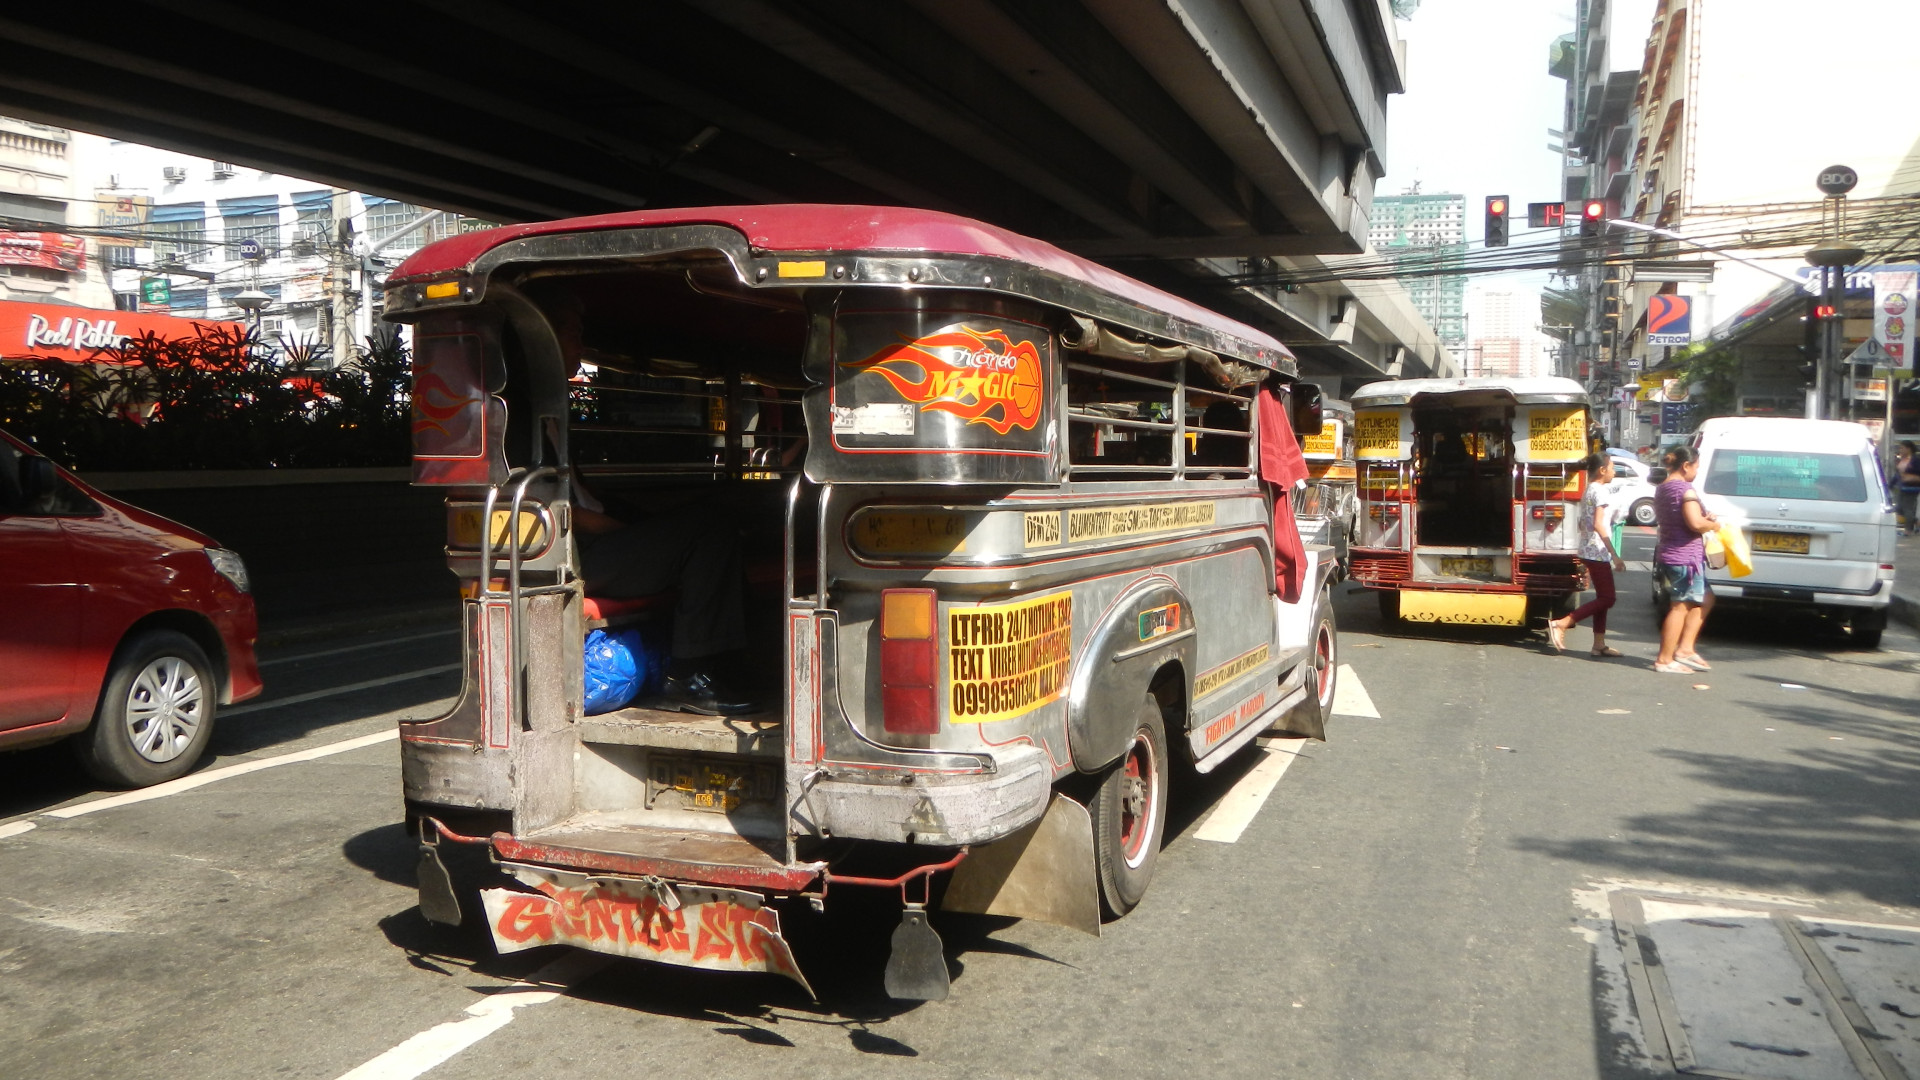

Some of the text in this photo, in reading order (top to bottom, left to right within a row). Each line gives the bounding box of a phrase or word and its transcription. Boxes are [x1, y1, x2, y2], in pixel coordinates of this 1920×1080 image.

[1821, 173, 1854, 184] BDO
[1544, 204, 1563, 226] 14
[240, 245, 258, 254] BDO
[27, 313, 73, 348] Red
[1648, 334, 1690, 344] PETRON
[1026, 513, 1060, 543] DFM 260
[1782, 535, 1808, 548] 526
[951, 612, 1004, 647] LTFRB
[1007, 607, 1028, 643] 24/7
[951, 648, 985, 681] TEXT
[989, 644, 1017, 679] VIBER
[1205, 691, 1265, 748] FIGHTING MAROON
[497, 881, 691, 954] GENTLE
